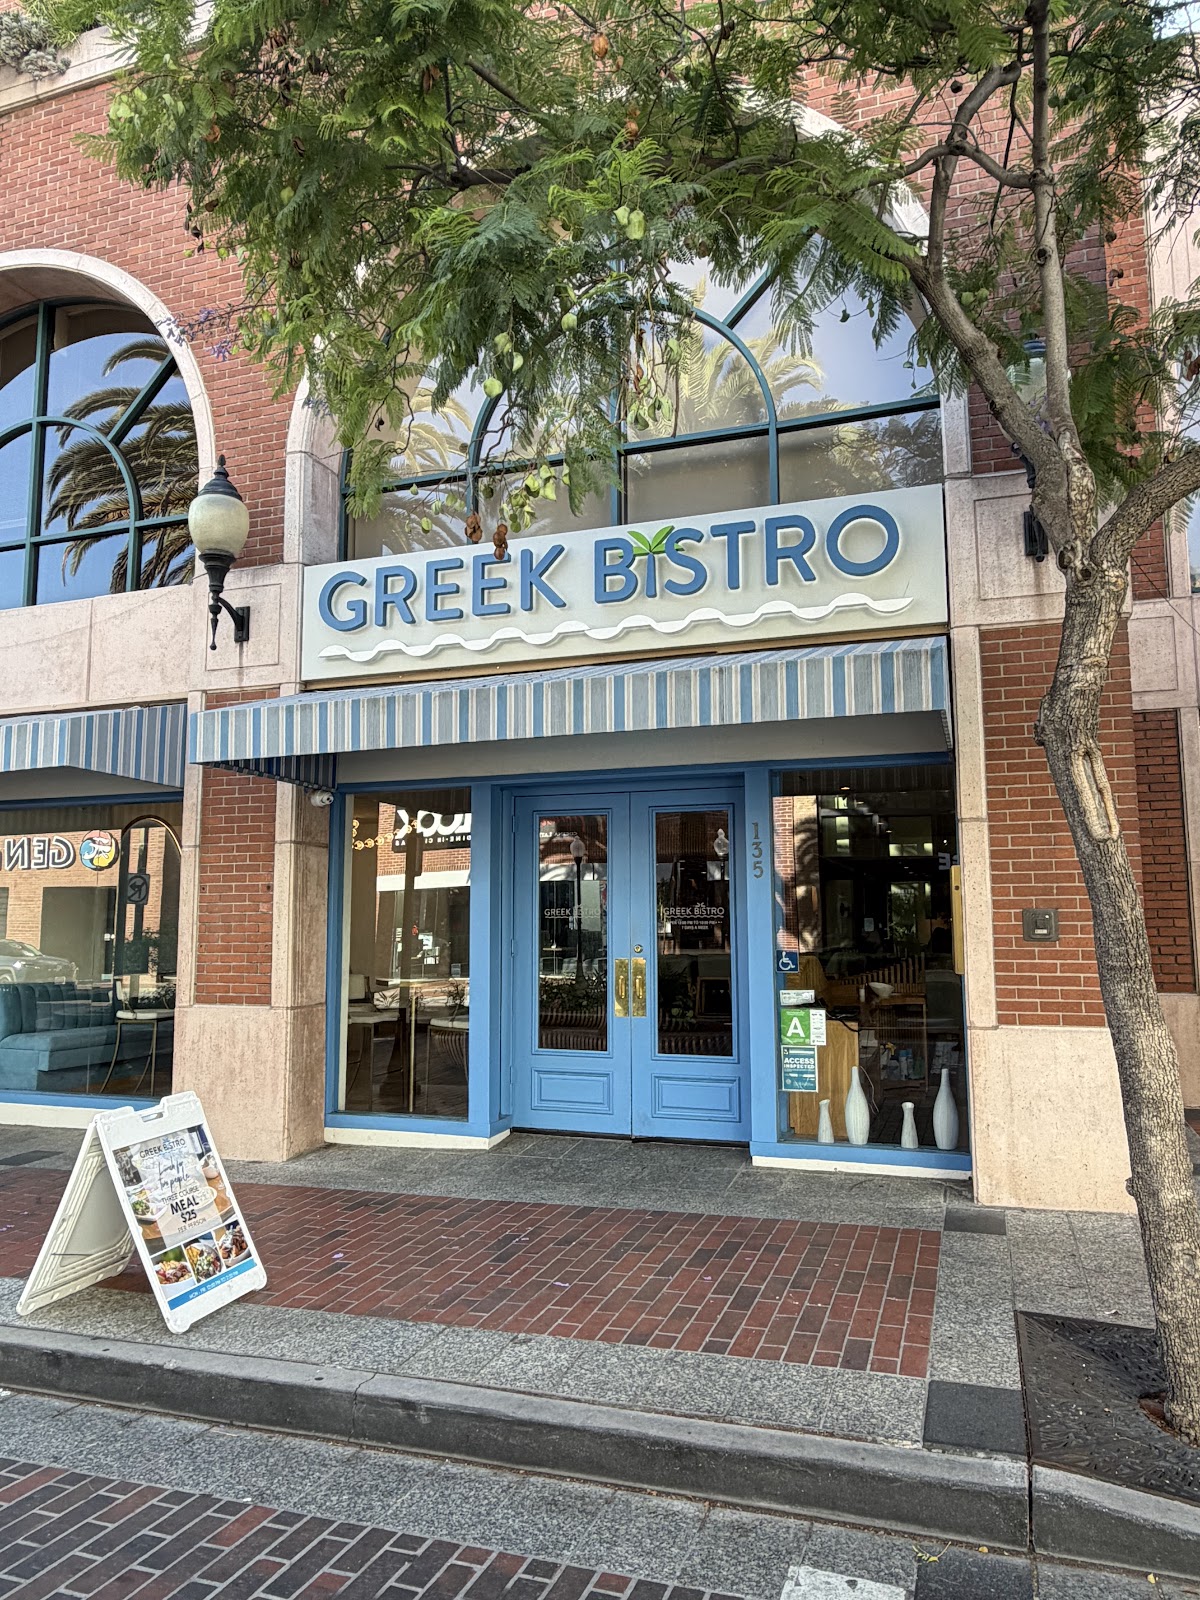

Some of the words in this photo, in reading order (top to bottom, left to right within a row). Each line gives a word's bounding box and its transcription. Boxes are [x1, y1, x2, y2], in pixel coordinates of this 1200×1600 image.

[318, 544, 566, 633] GREEK
[594, 504, 900, 604] BISTRO
[751, 821, 764, 879] 135
[544, 908, 571, 916] GREEK
[663, 907, 692, 915] GREEK
[694, 907, 725, 915] BISTRO
[786, 1016, 806, 1038] A
[139, 1145, 163, 1159] GREEK
[161, 1192, 178, 1205] THREE
[179, 1185, 200, 1198] COURSE
[170, 1195, 200, 1215] MEAL
[178, 1225, 187, 1233] PER
[187, 1217, 207, 1229] PERSON
[180, 1209, 197, 1224] $25
